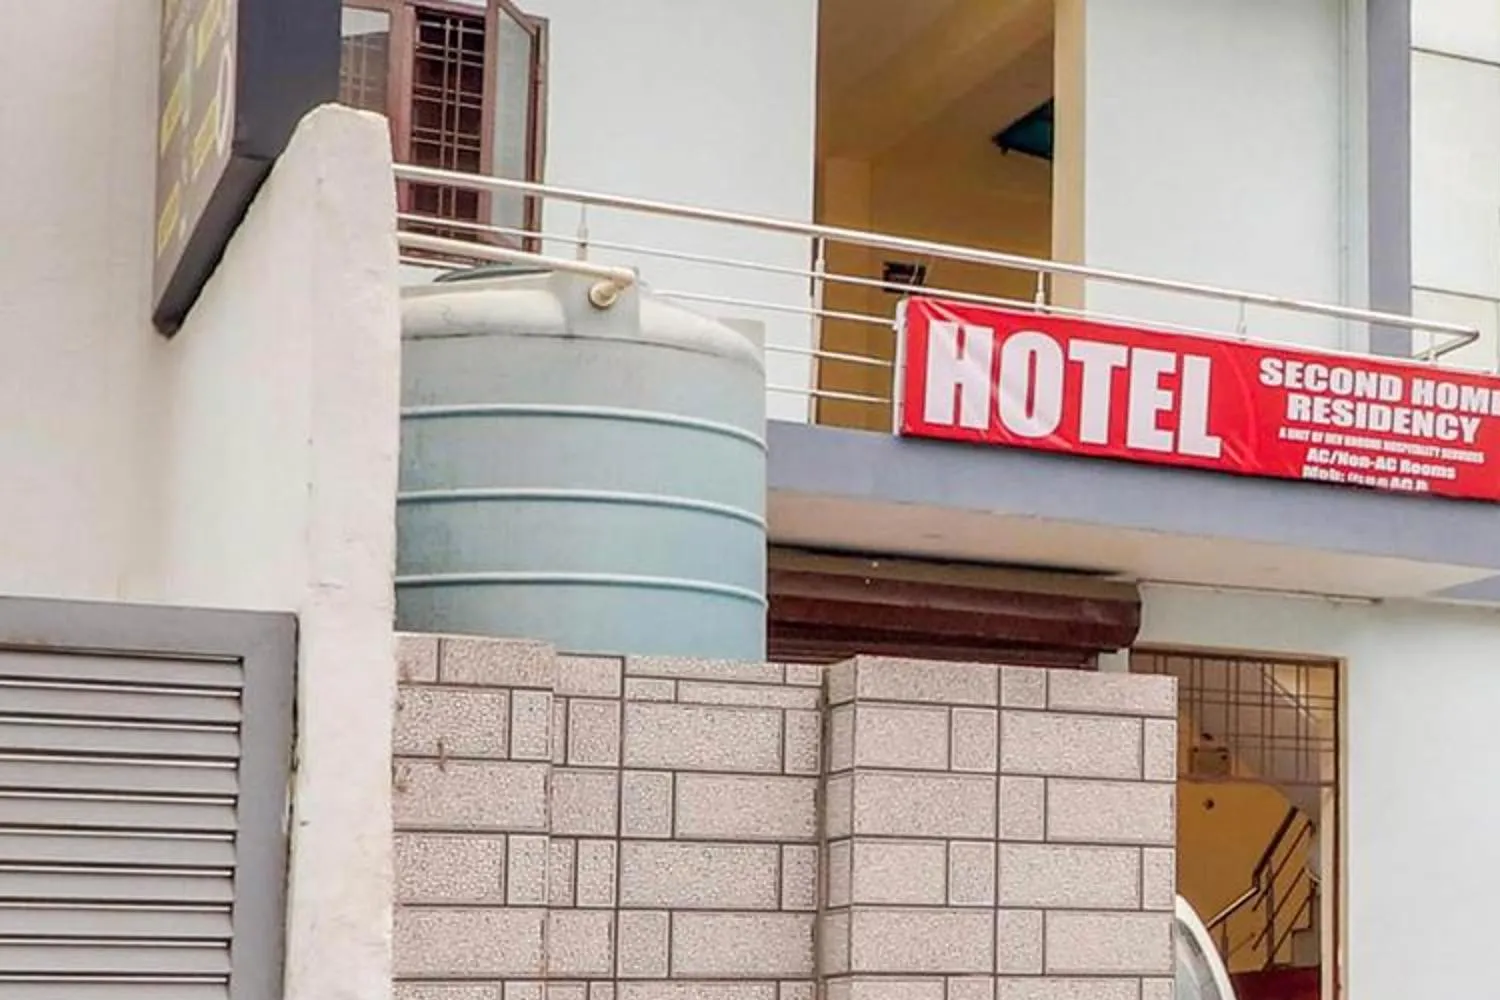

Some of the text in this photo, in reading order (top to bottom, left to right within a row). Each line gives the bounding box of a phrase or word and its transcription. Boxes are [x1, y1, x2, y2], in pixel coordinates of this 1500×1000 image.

[923, 319, 1222, 458] HOTEL
[1259, 357, 1403, 403] SECOND
[1286, 392, 1481, 444] RESIDENCY
